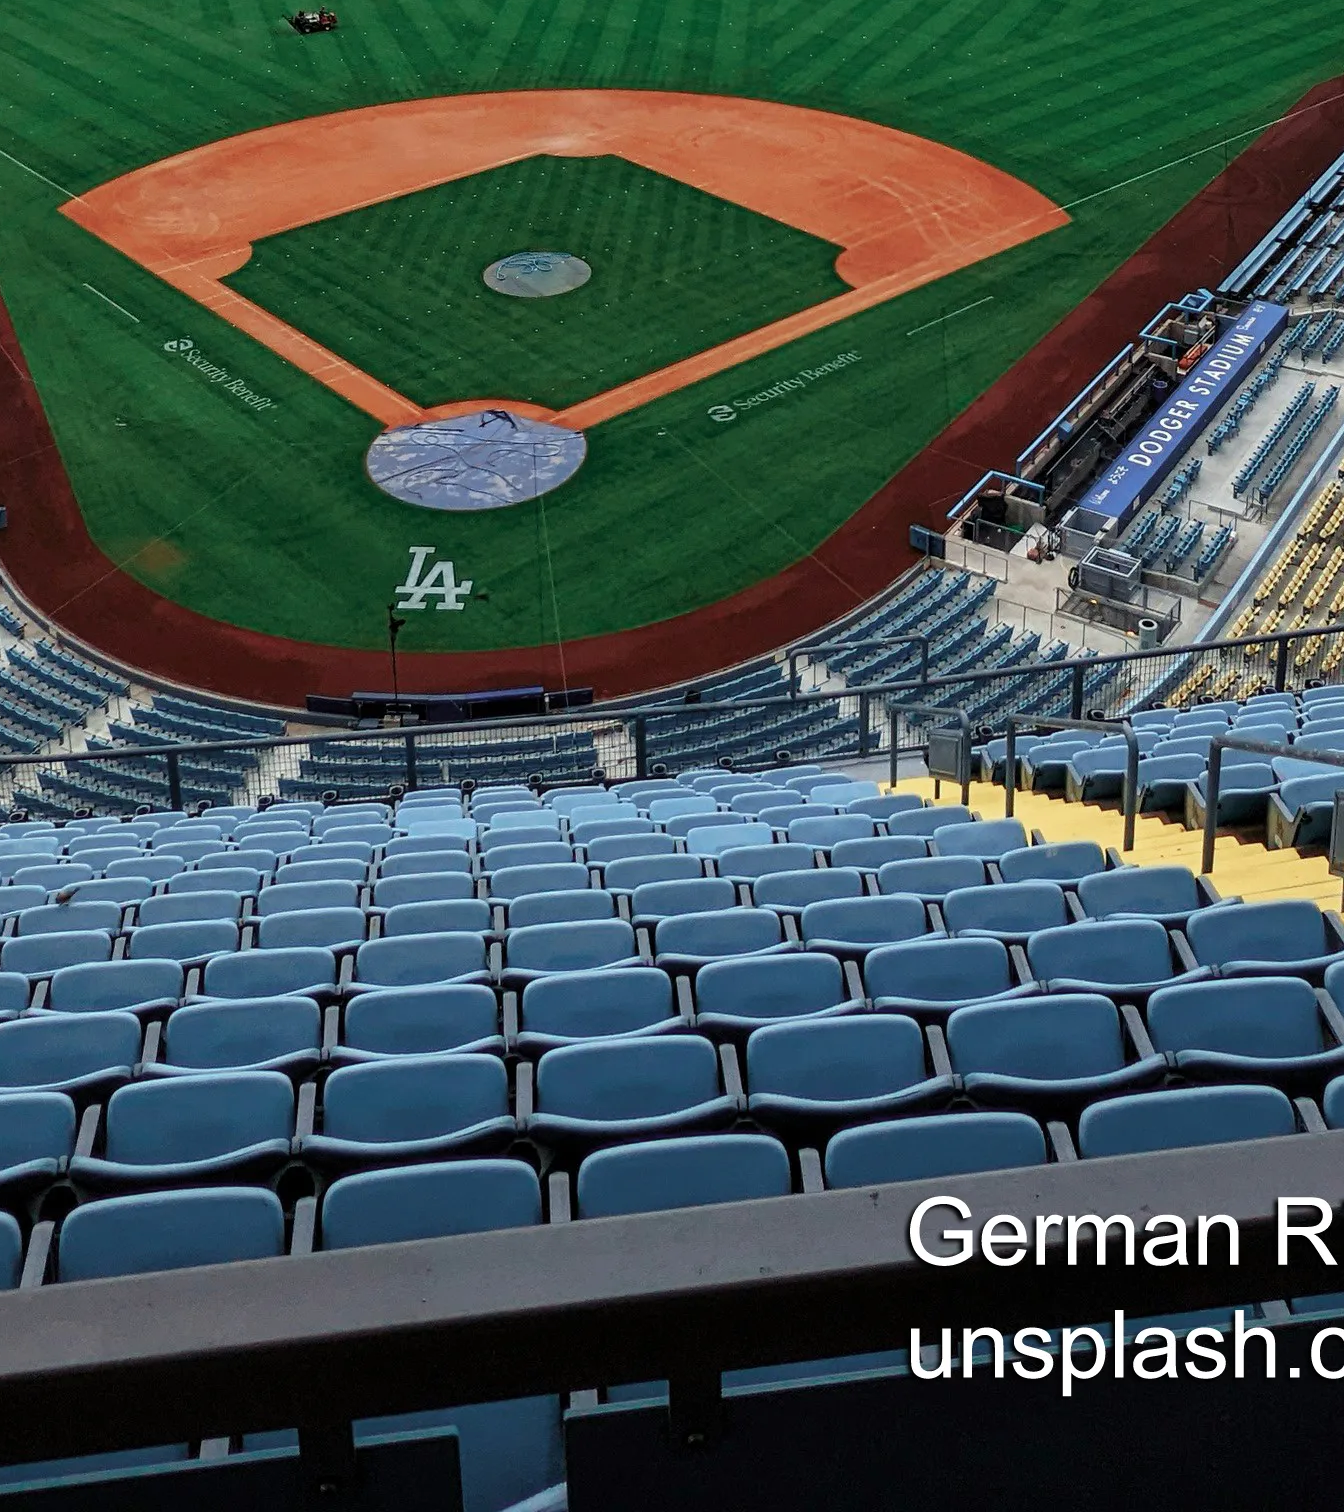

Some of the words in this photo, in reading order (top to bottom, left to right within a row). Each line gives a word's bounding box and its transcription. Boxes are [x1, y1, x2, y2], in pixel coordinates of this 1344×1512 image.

[180, 348, 231, 384] Security
[224, 378, 272, 412] Benefit
[733, 375, 806, 411] Security
[802, 350, 862, 382] Benefit
[1128, 400, 1199, 468] DODGER
[1188, 333, 1255, 396] STADIUM
[395, 546, 473, 610] LA
